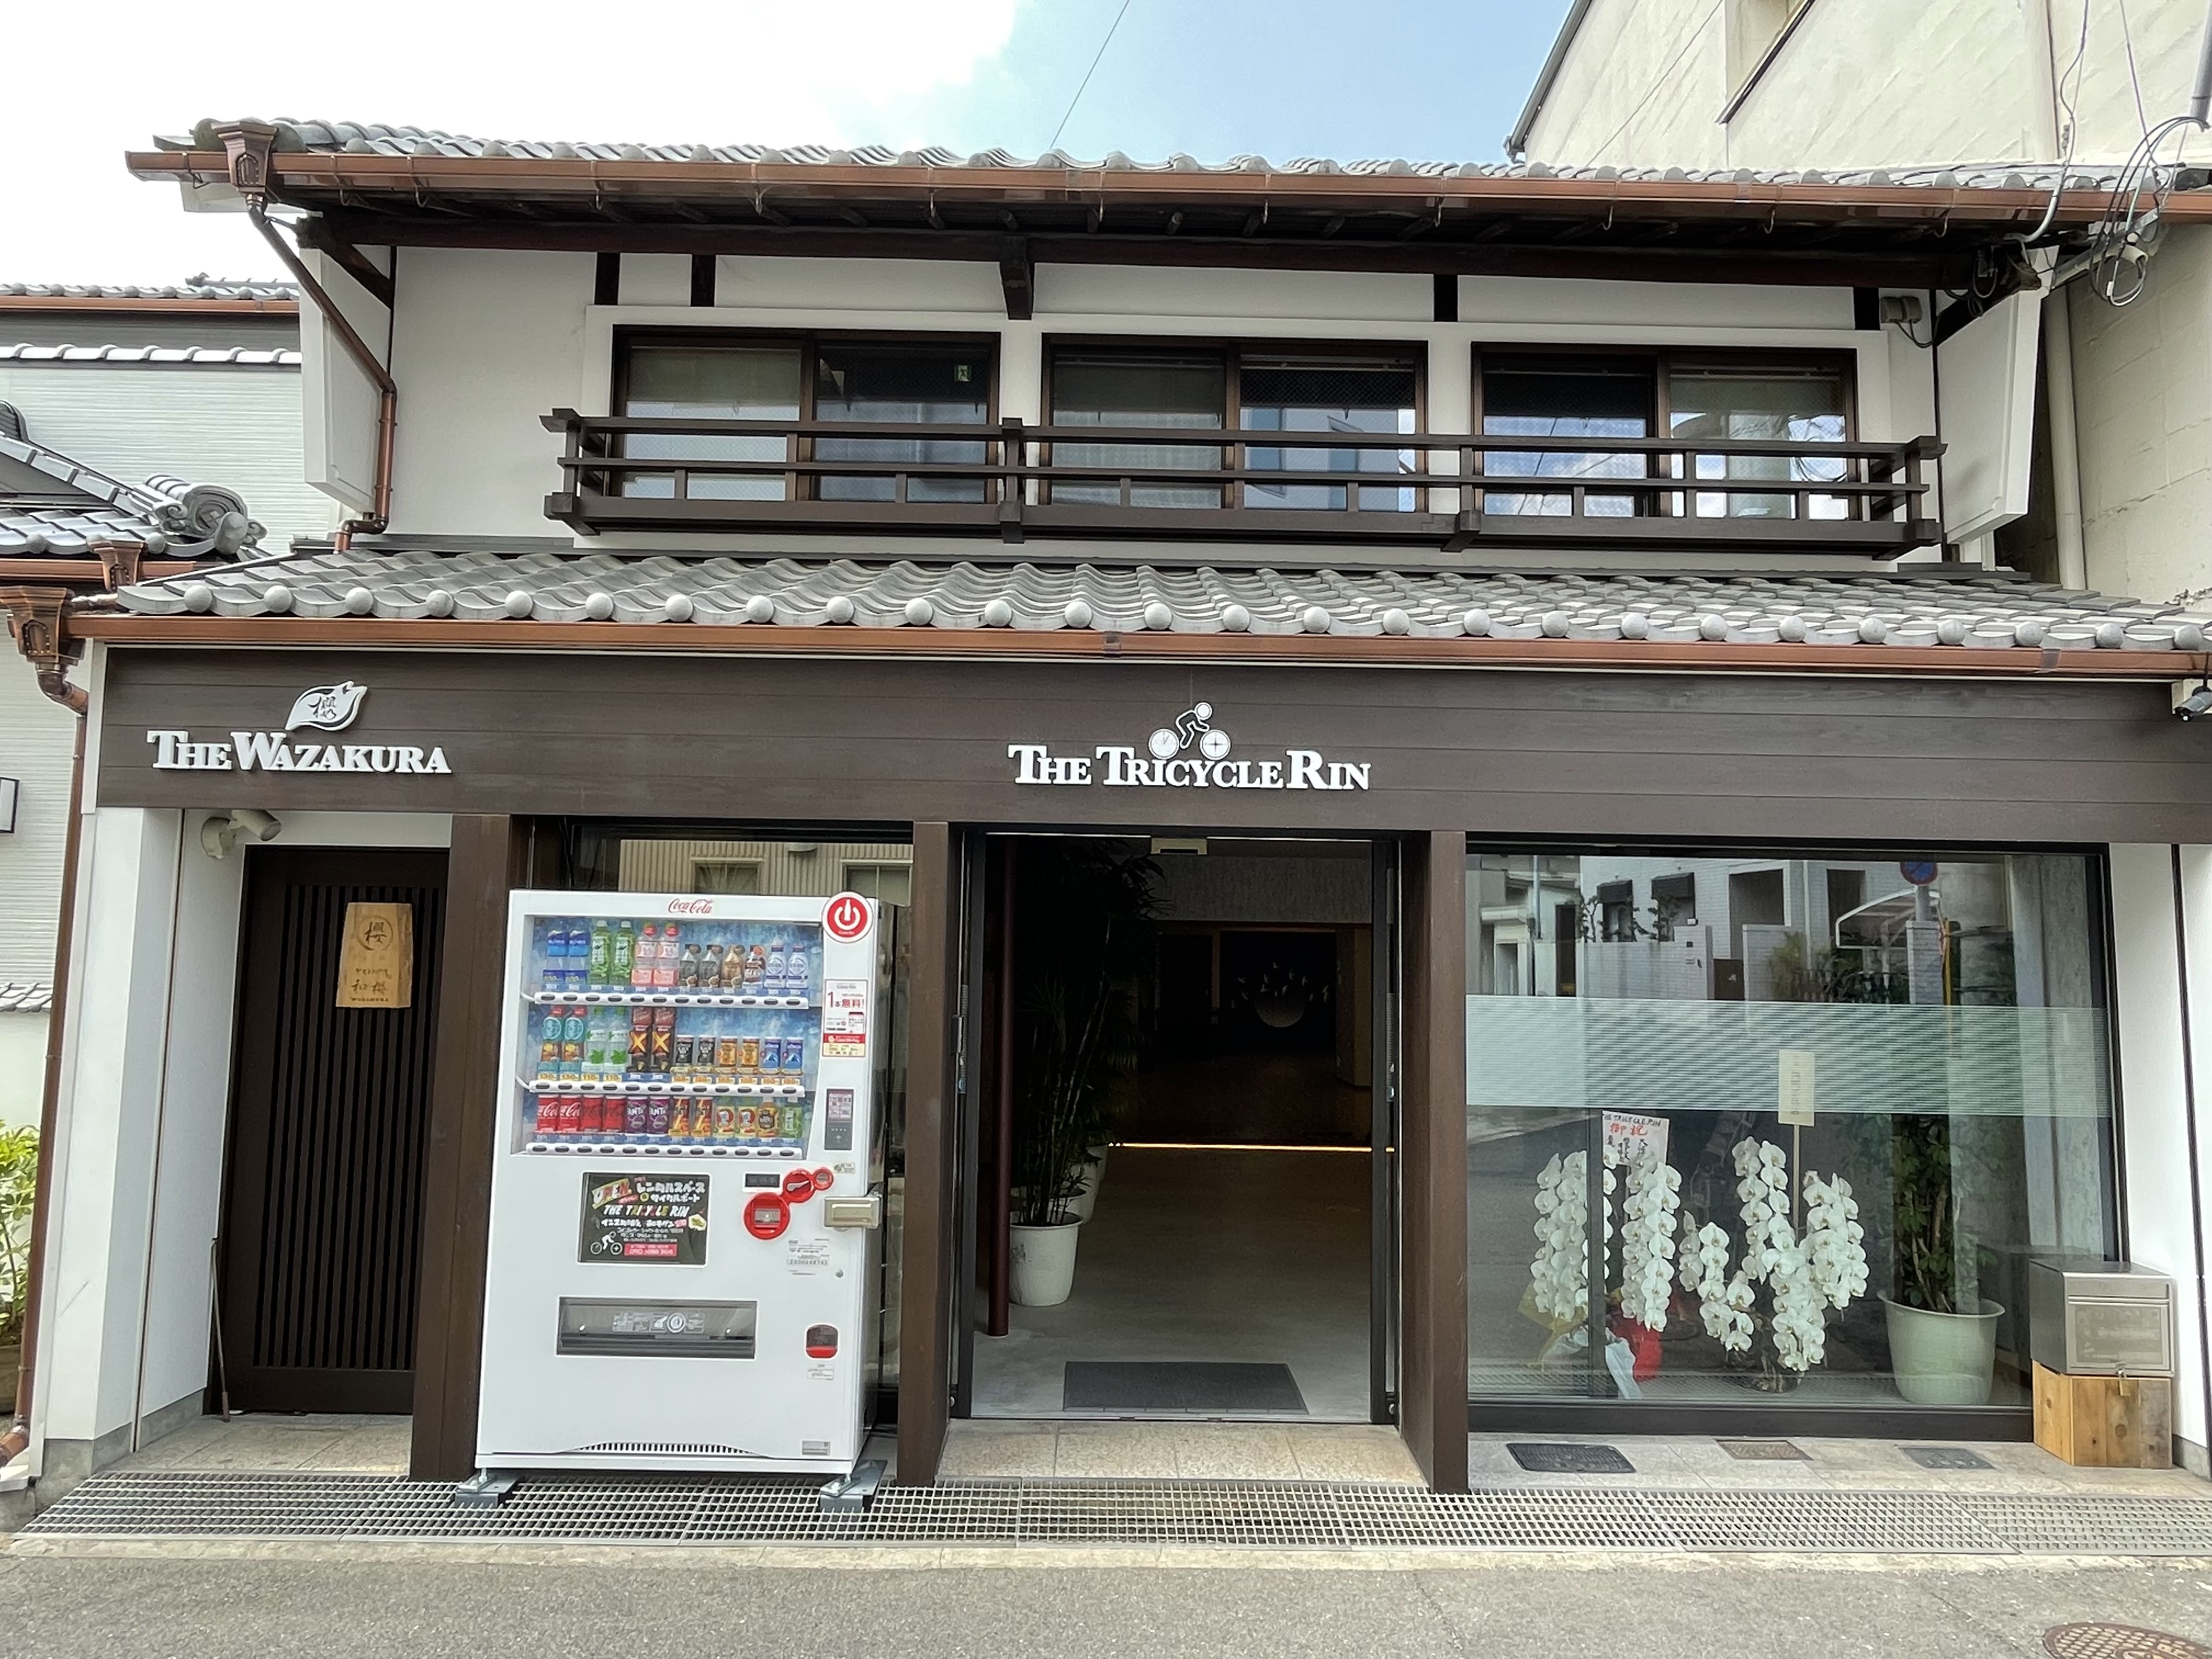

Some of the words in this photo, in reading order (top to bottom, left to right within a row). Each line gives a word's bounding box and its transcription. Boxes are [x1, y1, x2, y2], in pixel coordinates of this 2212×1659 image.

[146, 730, 233, 770] THE
[230, 732, 452, 774] WAZAKURA
[1007, 744, 1092, 785] THE
[1096, 746, 1283, 789] TRICYCLE
[1285, 749, 1372, 790] RIN
